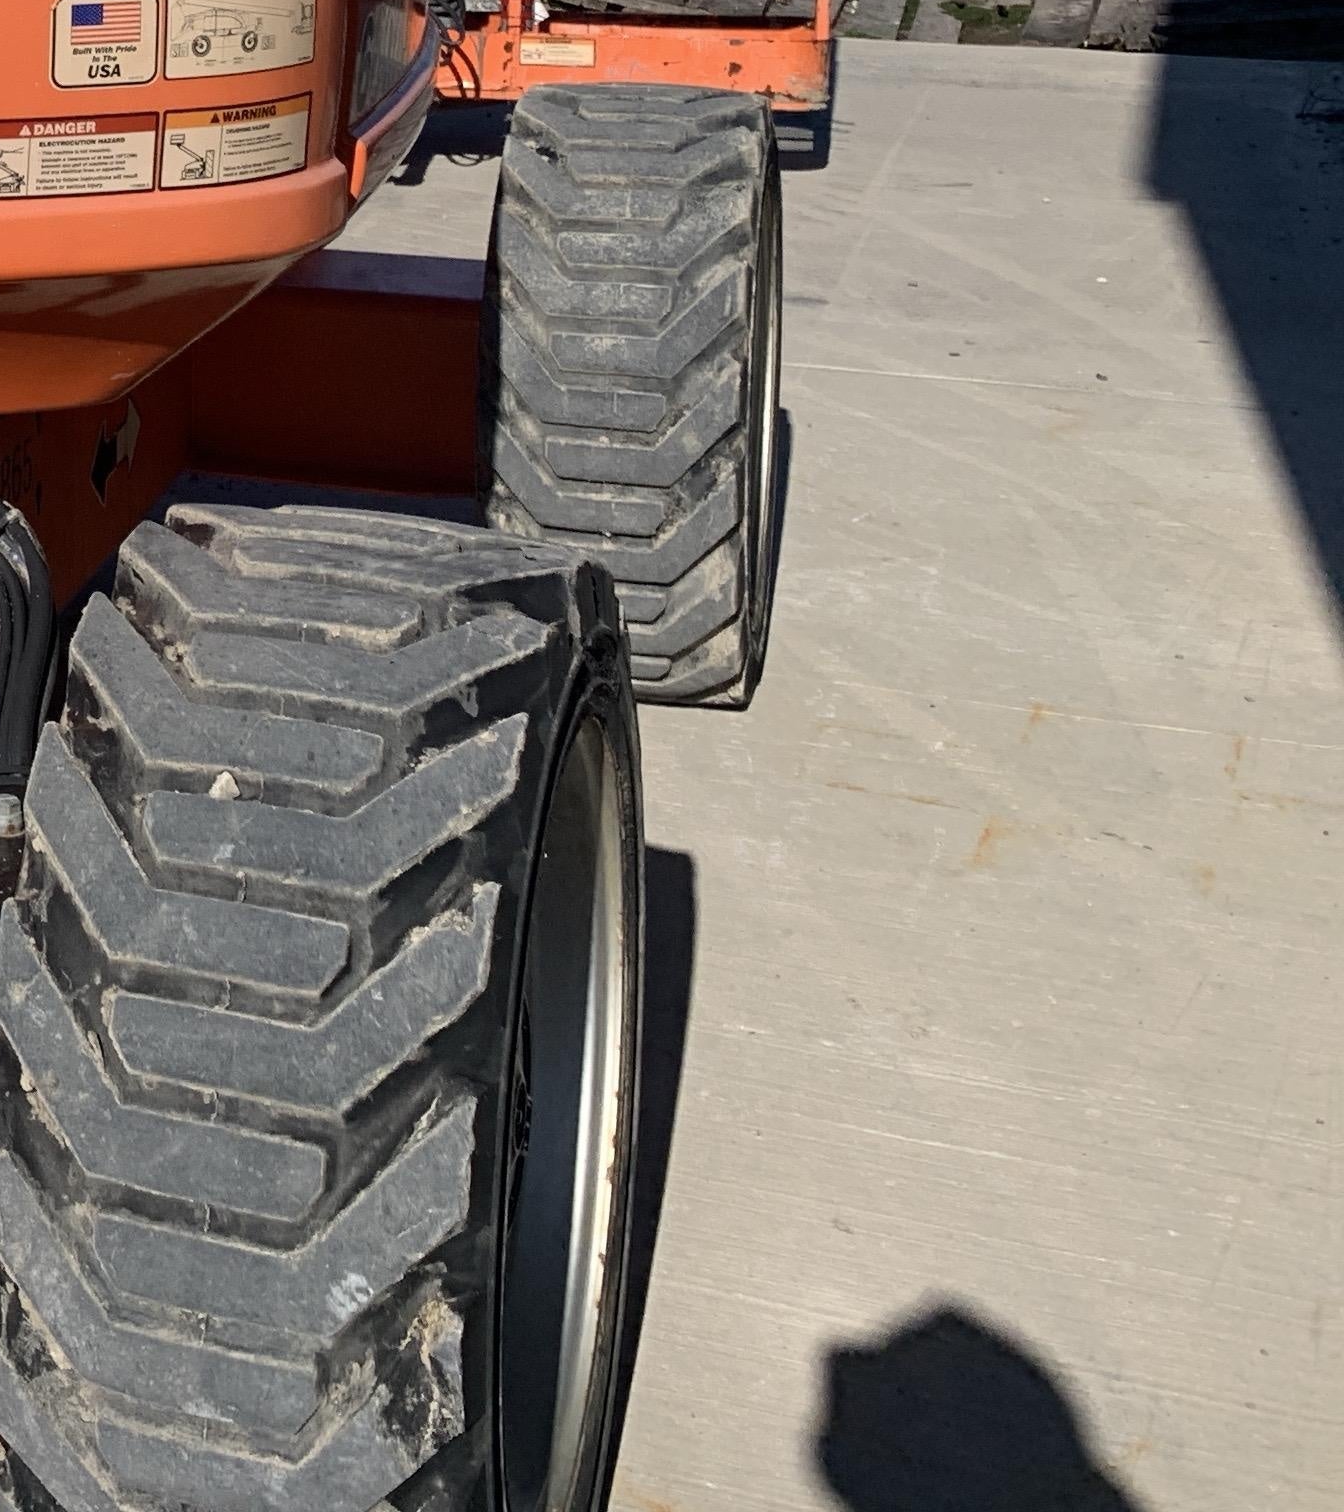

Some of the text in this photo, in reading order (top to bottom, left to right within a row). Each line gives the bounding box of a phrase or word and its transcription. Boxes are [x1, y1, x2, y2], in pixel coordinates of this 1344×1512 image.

[94, 46, 113, 54] With
[115, 44, 138, 53] Pride
[87, 63, 121, 79] USA
[223, 105, 277, 122] WARNING
[33, 121, 96, 135] DANGER
